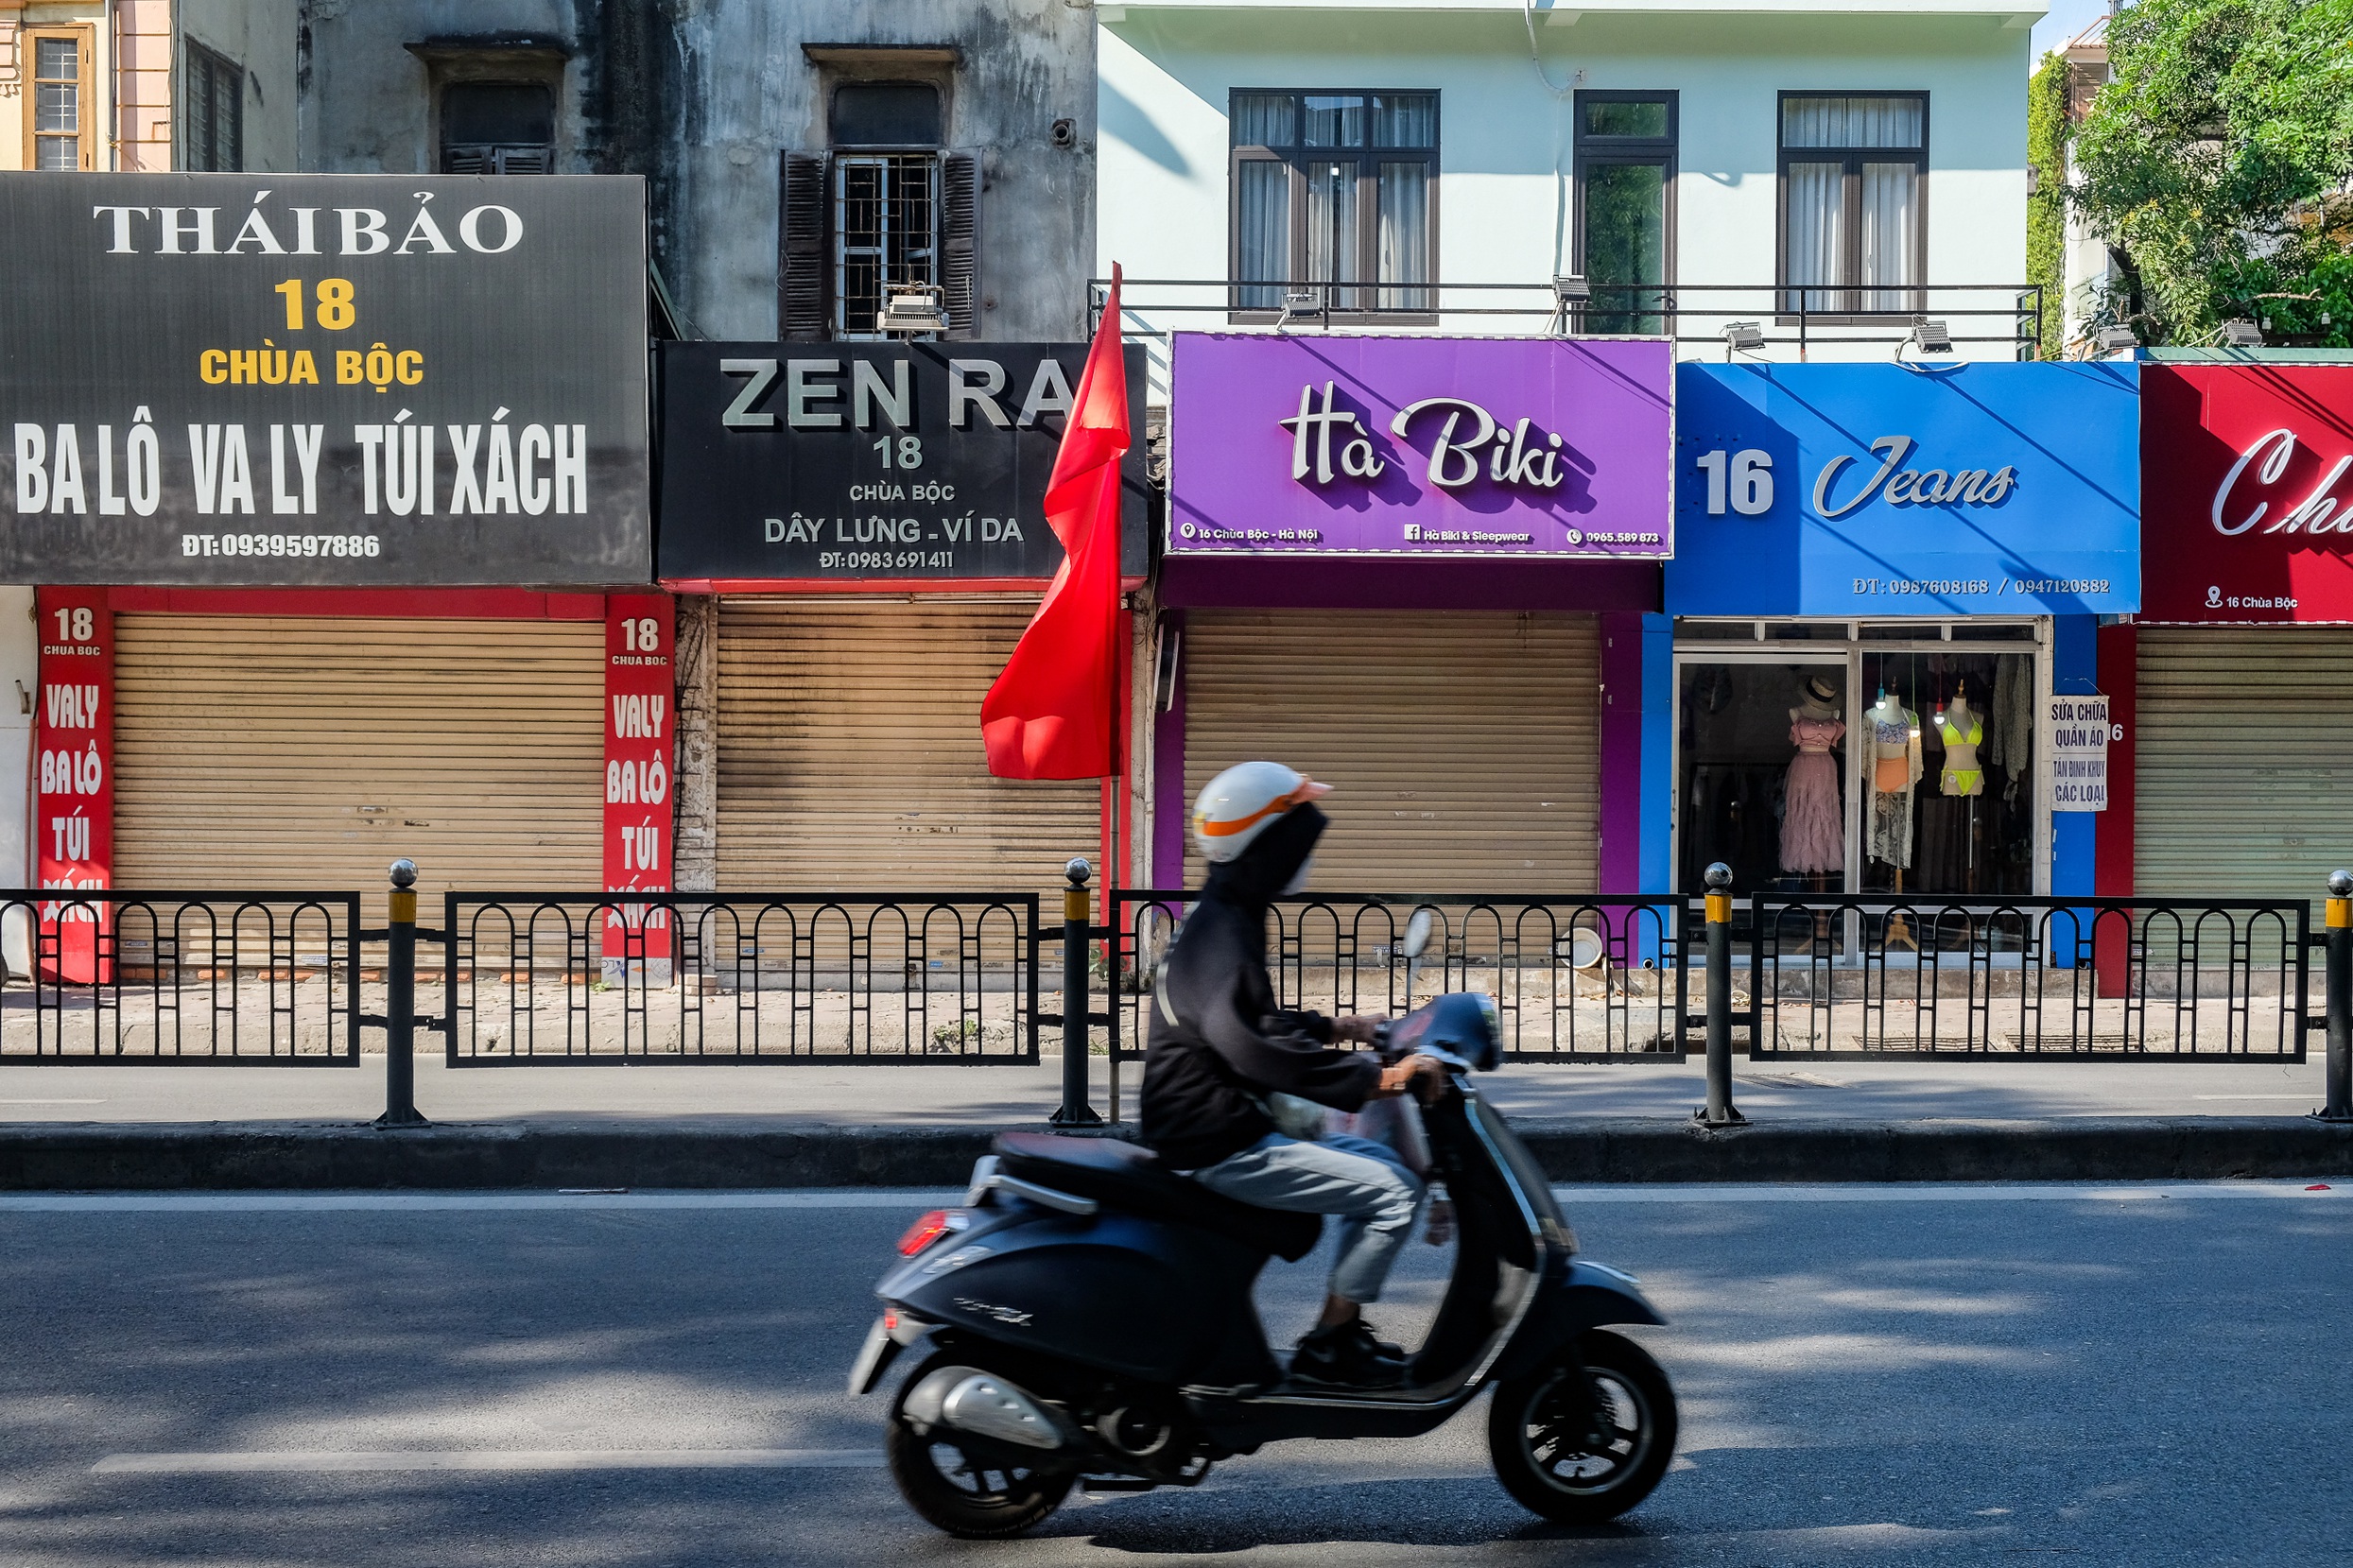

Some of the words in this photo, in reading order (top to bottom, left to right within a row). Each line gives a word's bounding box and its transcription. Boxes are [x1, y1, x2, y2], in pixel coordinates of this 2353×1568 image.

[94, 190, 321, 256] THÁI
[333, 192, 523, 255] BẢO
[276, 279, 355, 330] 18
[200, 339, 319, 384] CHÙA
[337, 343, 423, 392] BỘC
[720, 359, 910, 426] ZEN
[948, 359, 1075, 426] RA
[1277, 379, 1385, 484] Hà
[1390, 397, 1566, 487] Biki
[15, 423, 87, 514] BA
[98, 405, 160, 516] LÔ
[188, 424, 255, 514] VA
[270, 424, 323, 514] LY
[355, 408, 434, 516] TÚI
[447, 406, 587, 515] XÁCH
[874, 436, 922, 469] 18
[850, 480, 905, 500] CHÙA
[913, 481, 954, 504] BỘC
[1697, 449, 1774, 515] 16
[1812, 435, 2015, 518] Jeans
[766, 512, 824, 542] DÂY
[838, 516, 920, 543] LƯNG
[943, 510, 974, 542] VÍ
[982, 519, 1024, 541] DA
[1200, 529, 1212, 539] 16
[1213, 527, 1244, 540] Chùa
[1247, 527, 1270, 542] Bộc
[1279, 527, 1295, 540] Hà
[1298, 527, 1318, 542] Nội
[1425, 529, 1440, 541] Hà
[1442, 530, 1461, 541] Biki
[1462, 531, 1471, 541] &
[1472, 530, 1530, 544] Sleepwear
[182, 534, 380, 557] ĐT:0939597886
[1853, 578, 1887, 595] ĐT:
[1890, 579, 1990, 595] 0987608168
[2015, 579, 2110, 595] 0947120882
[2226, 597, 2239, 608] 16
[2241, 597, 2272, 609] Chùa
[2275, 596, 2298, 611] Bộc
[55, 609, 92, 640] 18
[622, 619, 658, 651] 18
[45, 684, 99, 728] VALY
[613, 695, 664, 738] VALY
[2051, 698, 2073, 720] SỬA
[2077, 700, 2106, 720] CHỮA
[2055, 724, 2086, 748] QUẦN
[2089, 727, 2103, 747] ÁO
[2087, 761, 2104, 777] KHUY
[2055, 782, 2077, 801] CÁC
[2081, 785, 2104, 805] LOẠI
[52, 805, 90, 861] TÚI
[622, 817, 658, 870] TÚI
